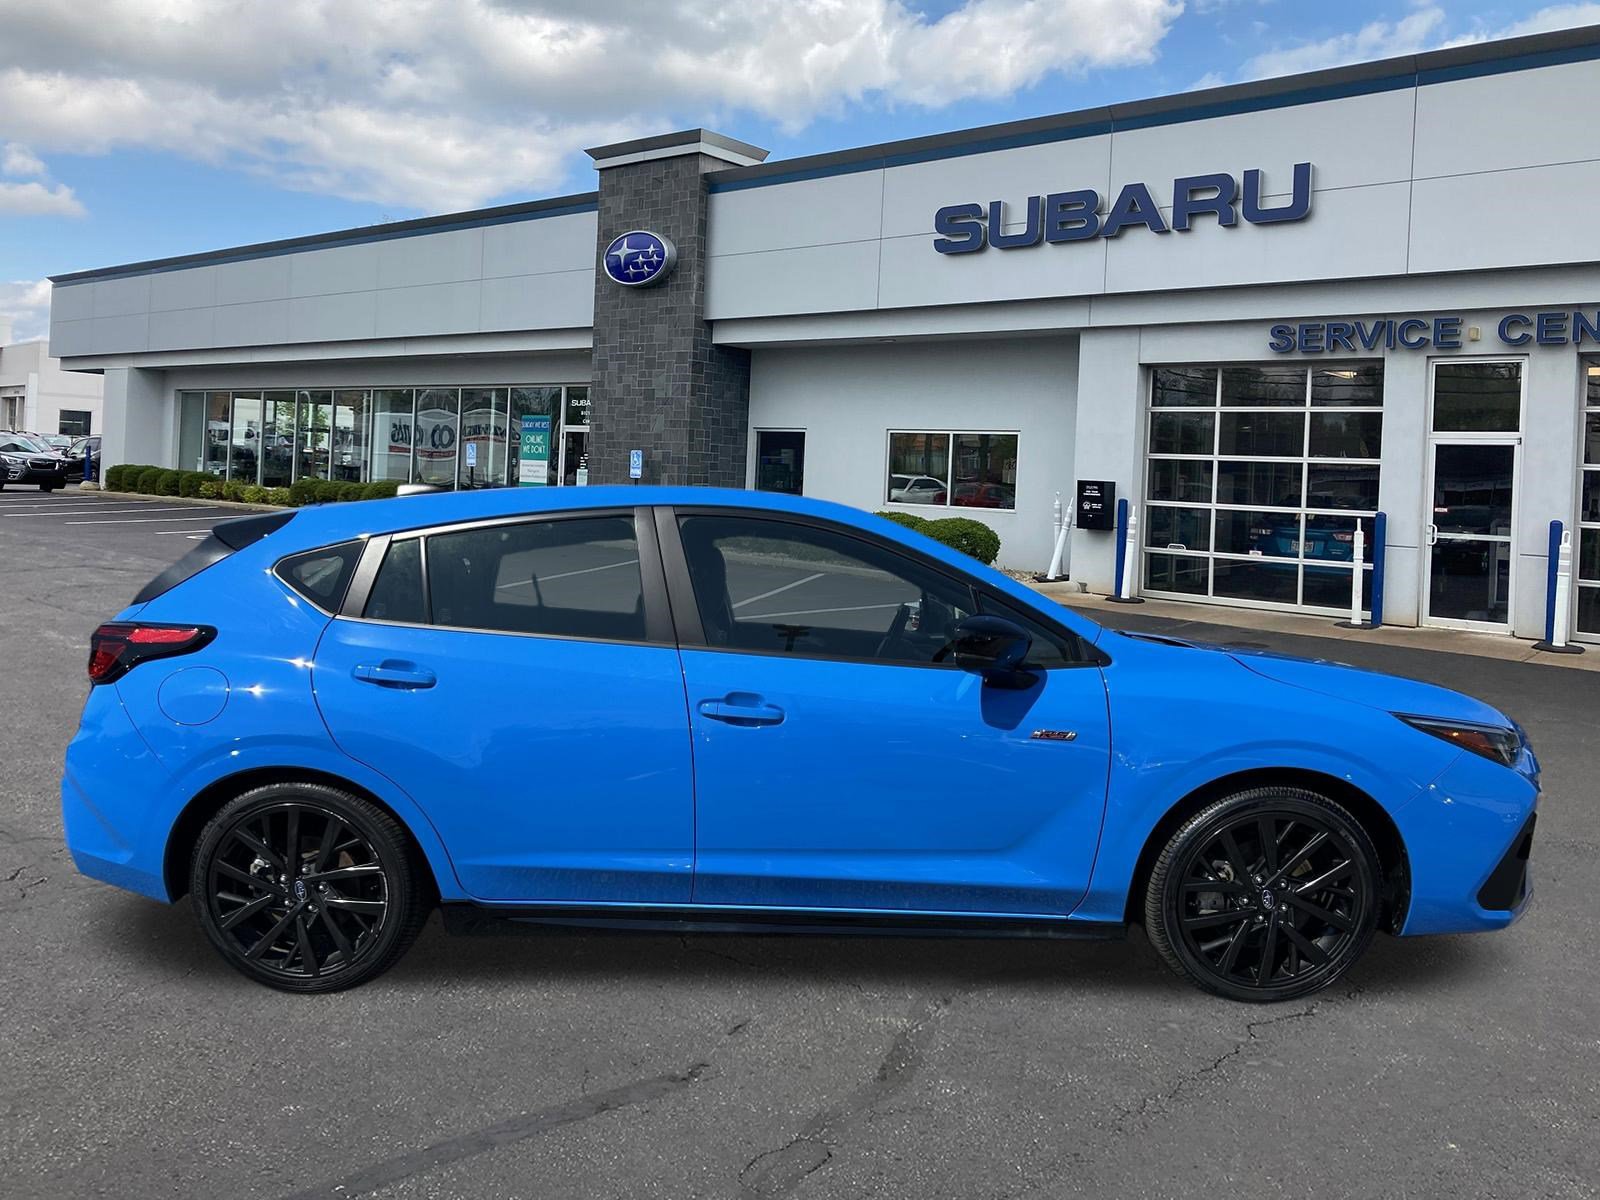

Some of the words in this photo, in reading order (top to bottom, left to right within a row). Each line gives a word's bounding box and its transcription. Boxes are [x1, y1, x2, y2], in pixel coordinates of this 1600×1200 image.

[933, 161, 1314, 255] SUBARU
[1268, 316, 1463, 353] SERVICE
[523, 445, 530, 453] WE
[525, 434, 543, 443] ONLINE
